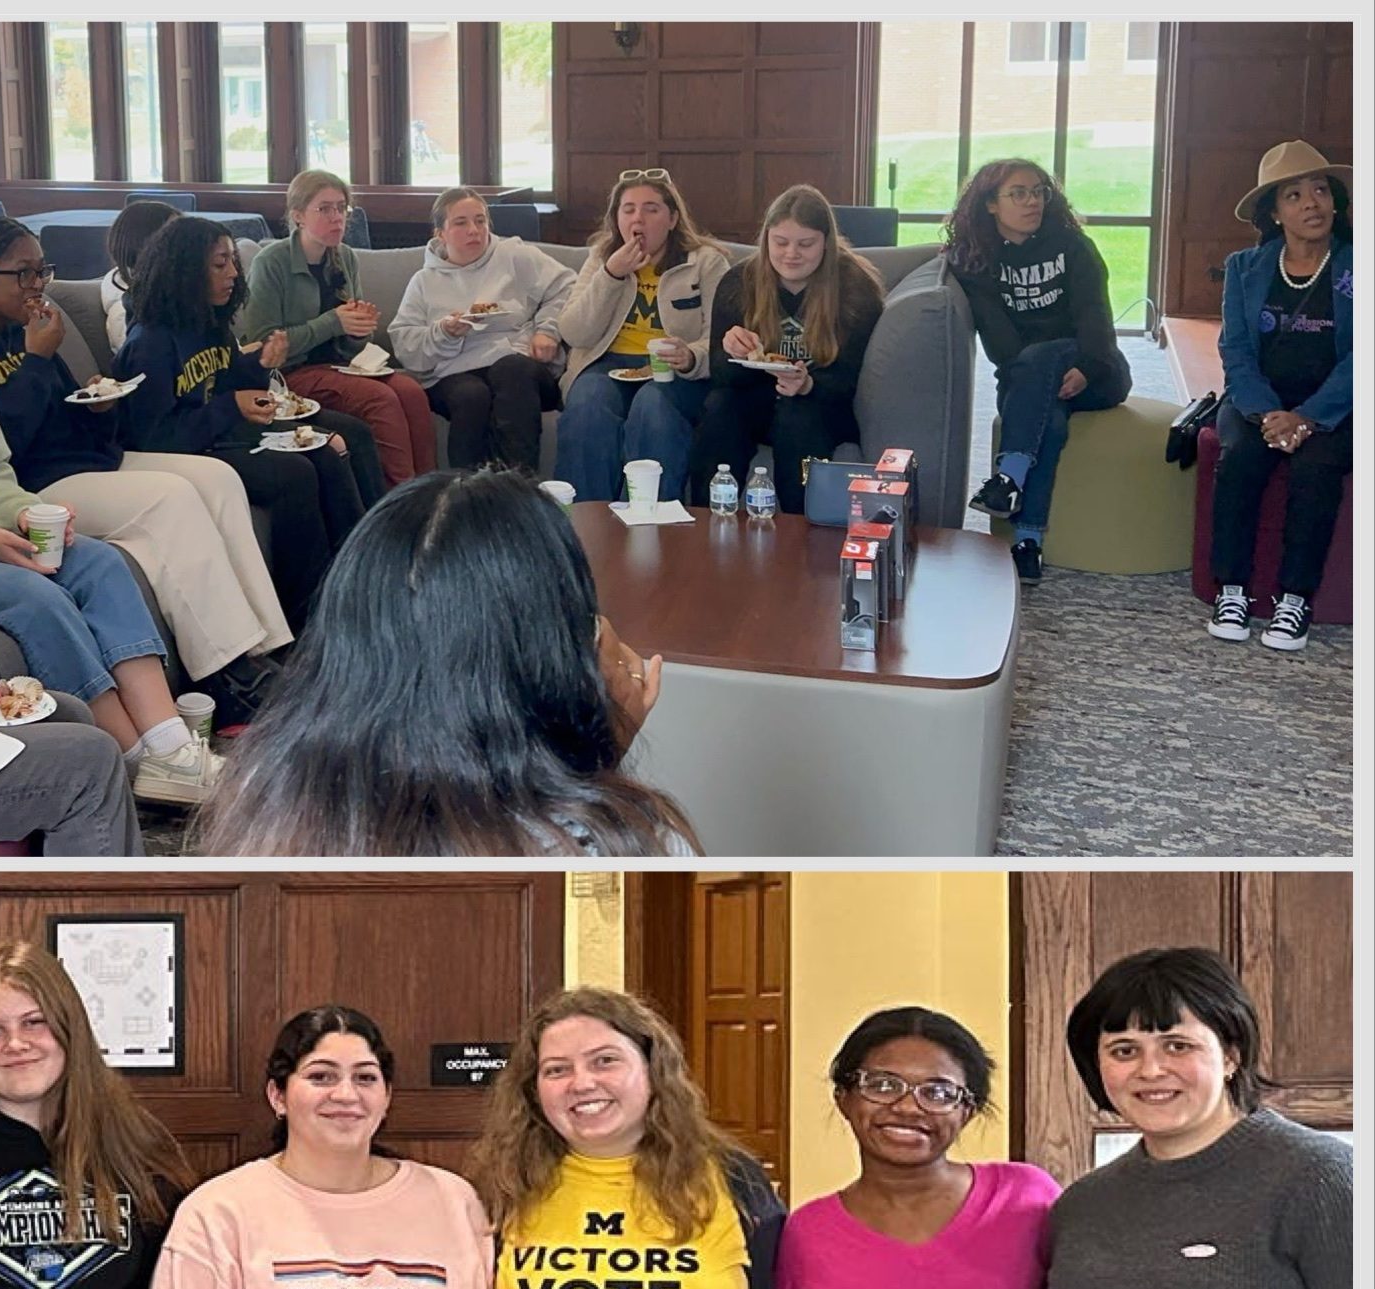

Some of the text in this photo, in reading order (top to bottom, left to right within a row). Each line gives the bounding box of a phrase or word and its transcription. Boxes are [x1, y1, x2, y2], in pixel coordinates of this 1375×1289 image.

[445, 1059, 508, 1070] OCCUPANCY
[584, 1211, 625, 1236] M
[513, 1246, 700, 1273] VICTORS
